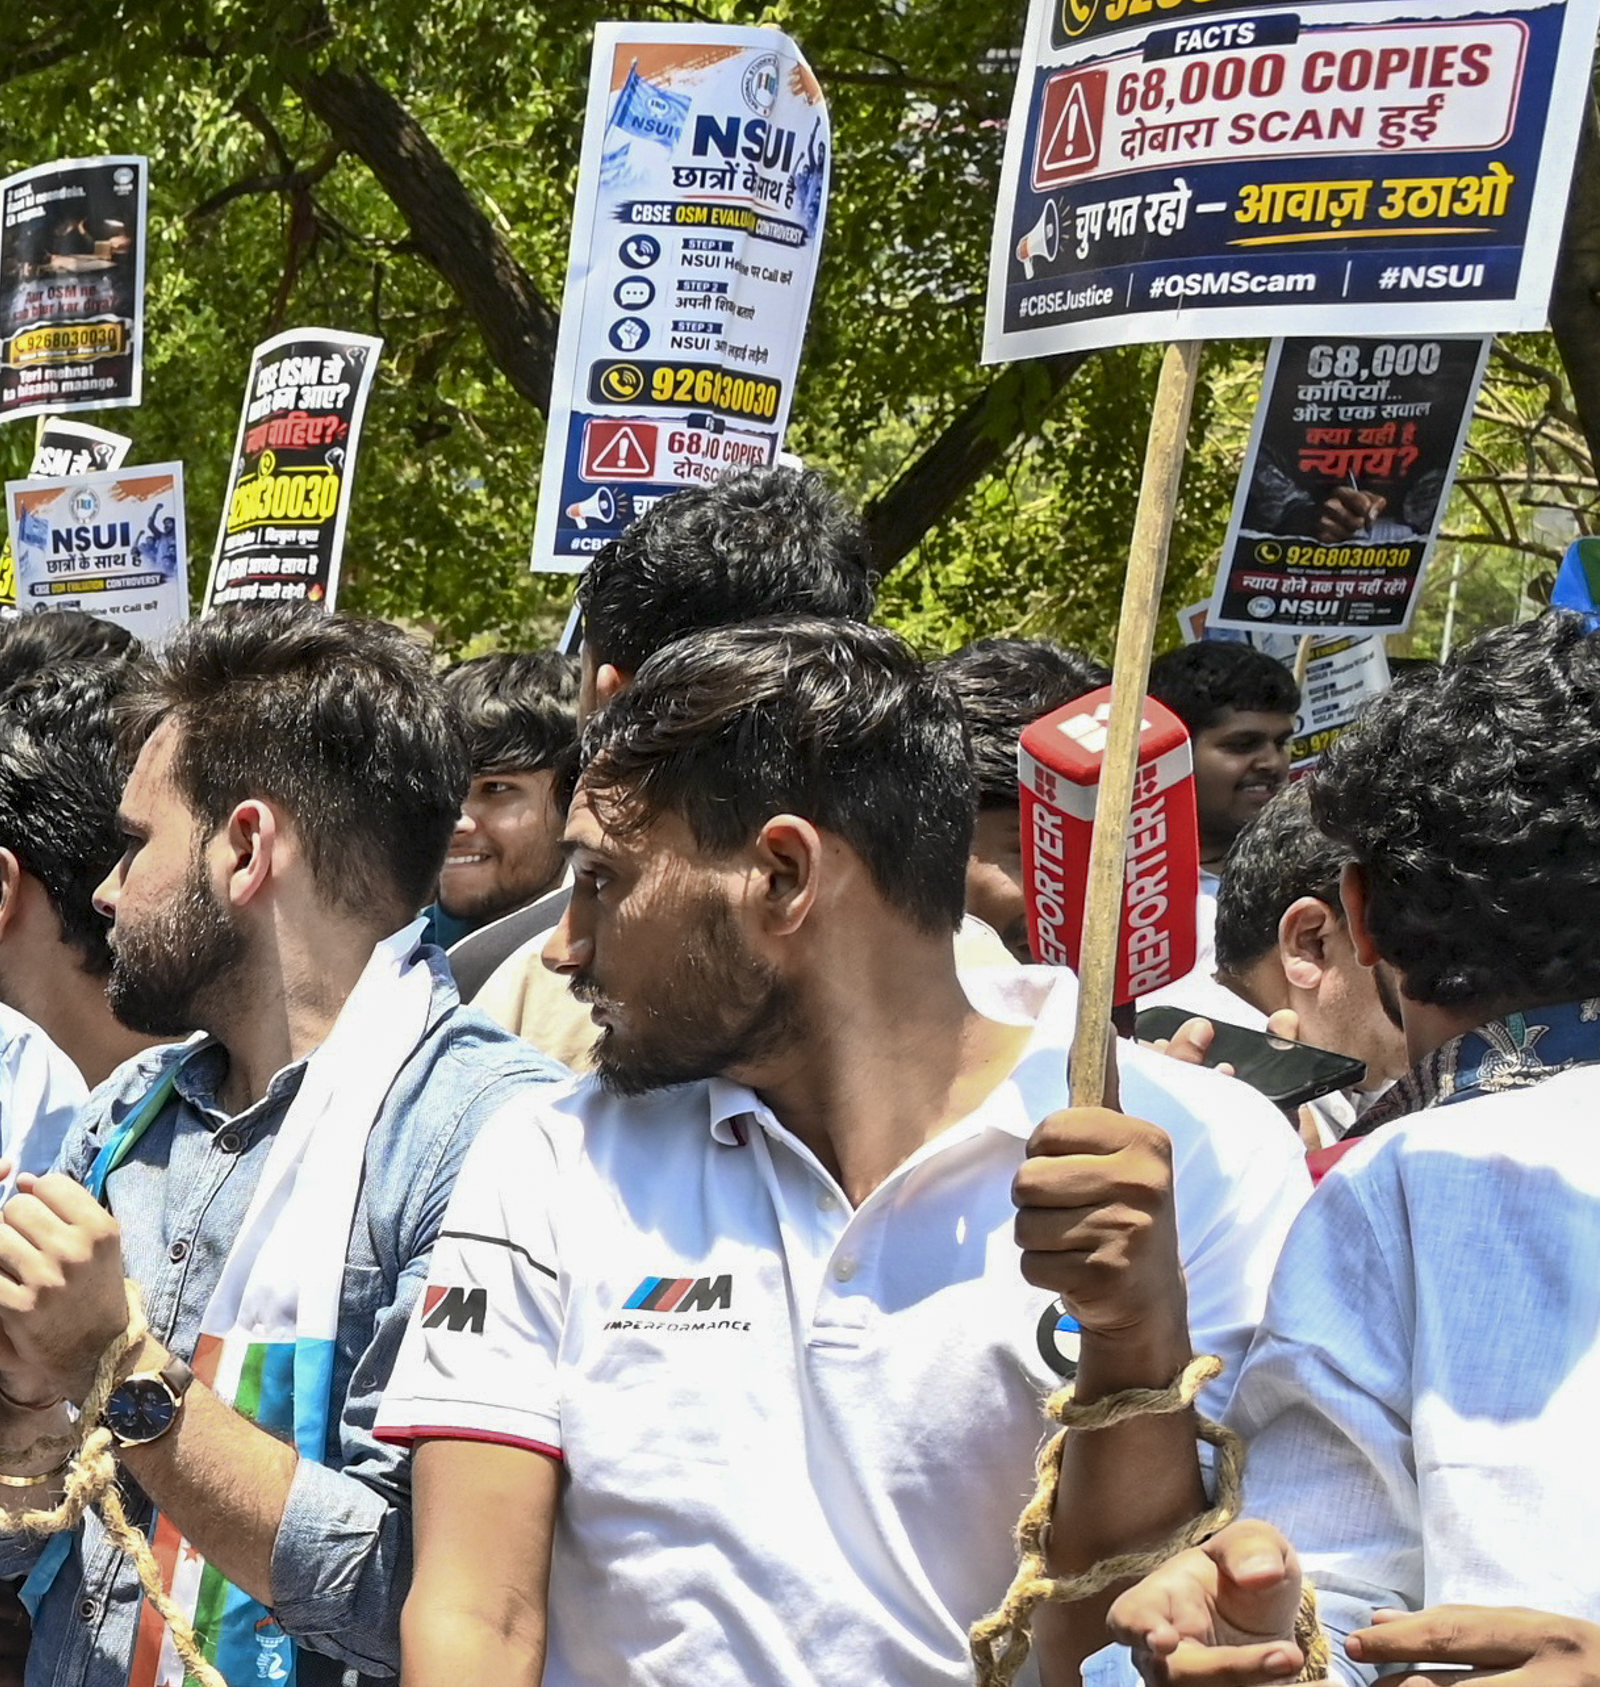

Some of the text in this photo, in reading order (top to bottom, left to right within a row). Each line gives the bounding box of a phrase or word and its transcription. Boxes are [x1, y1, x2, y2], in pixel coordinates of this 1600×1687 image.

[1174, 22, 1256, 54] FACTS
[1116, 43, 1492, 116] 68,000 COPIES
[692, 114, 796, 172] NSUI
[1120, 115, 1220, 160] दोबारा
[1228, 107, 1366, 145] SCAN
[672, 161, 740, 191] छात्रों
[631, 204, 707, 224] CBSE OSM
[1075, 161, 1515, 259] चुप मत रहो आवाज़ उठाओ
[1018, 263, 1484, 318] #CBSEJustice #OSMScam #NSUI
[1307, 342, 1442, 381] 68,000
[1292, 402, 1432, 422] और एक सवाल
[1306, 422, 1417, 447] क्या यही है
[1298, 445, 1419, 478] न्याय?
[51, 521, 131, 554] NSUI
[1286, 545, 1411, 568] 9268030030
[1243, 575, 1278, 593] न्याय
[1281, 576, 1308, 594] होने
[1310, 579, 1333, 594] तक
[1335, 581, 1355, 597] चुप
[1357, 578, 1382, 596] नहीं
[1279, 599, 1340, 616] NSUI
[1032, 802, 1067, 966] EPORTER
[1126, 796, 1171, 996] REPORTER
